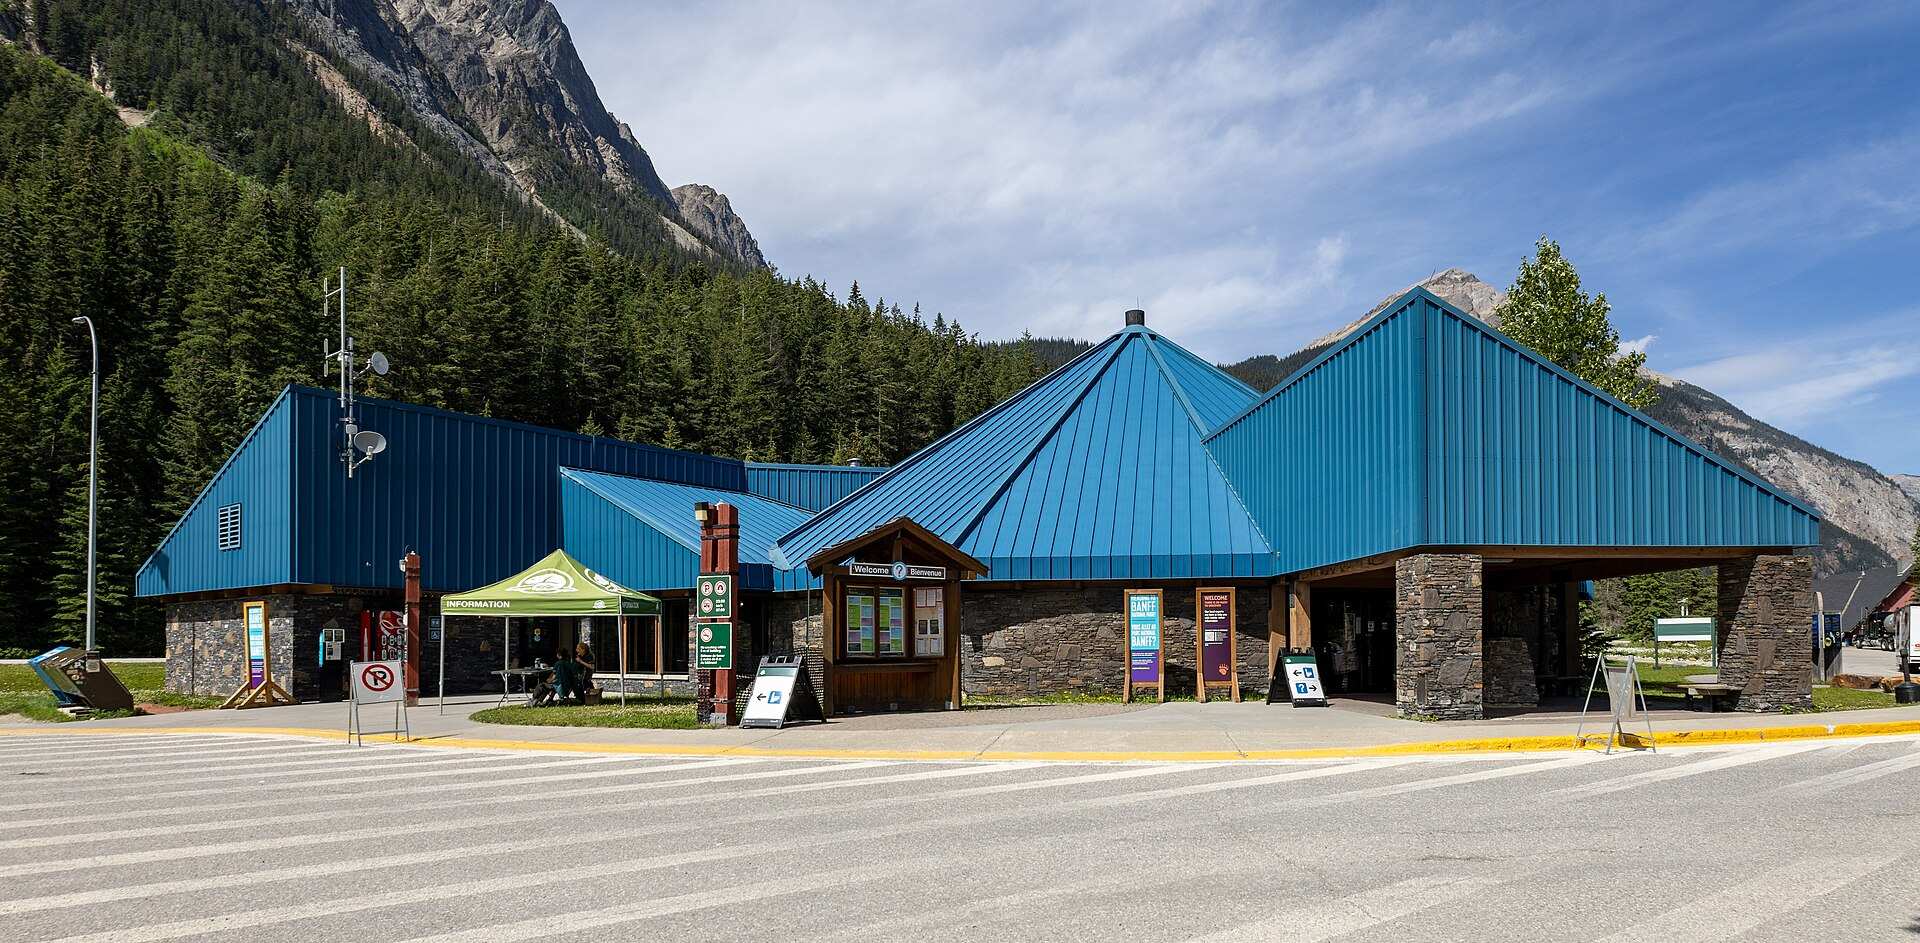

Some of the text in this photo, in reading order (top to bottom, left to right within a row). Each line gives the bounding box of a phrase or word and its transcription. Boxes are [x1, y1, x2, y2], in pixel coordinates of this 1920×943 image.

[854, 565, 889, 575] Welcome
[910, 568, 942, 577] Bienvenue
[446, 600, 510, 608] INFORMATION
[1131, 601, 1156, 612] BANFF
